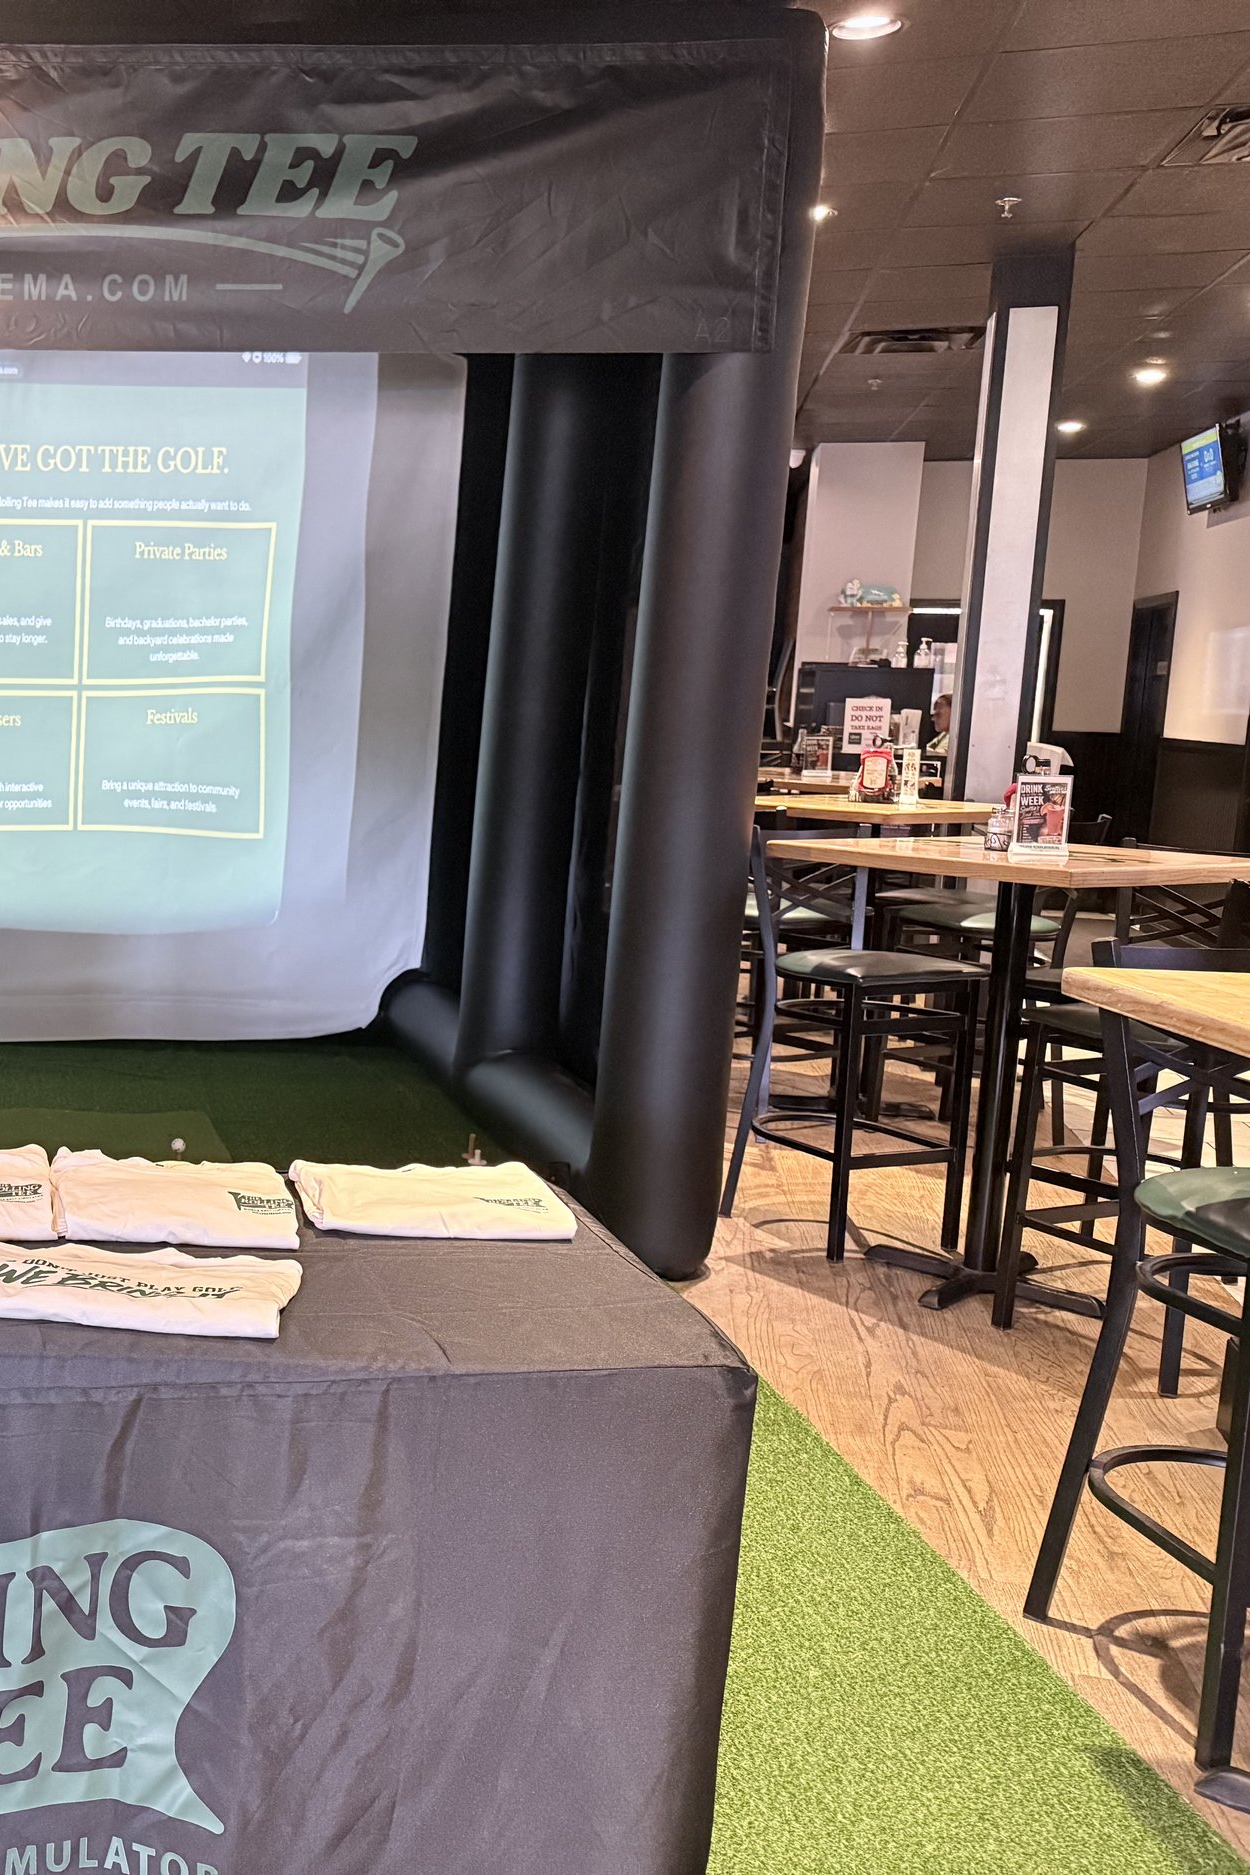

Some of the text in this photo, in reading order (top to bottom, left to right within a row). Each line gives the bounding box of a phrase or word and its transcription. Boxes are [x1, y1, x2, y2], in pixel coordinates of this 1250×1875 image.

[173, 133, 419, 219] TEE
[36, 444, 94, 473] GOT
[98, 445, 150, 474] THE
[156, 447, 229, 475] GOLF.
[23, 497, 37, 508] Tee
[38, 497, 64, 509] makes
[70, 499, 89, 511] easy
[89, 498, 97, 509] to
[98, 498, 113, 509] add
[113, 498, 151, 511] something
[152, 499, 180, 512] people
[180, 499, 209, 512] actually
[209, 500, 229, 511] want
[230, 501, 238, 511] to
[0, 540, 11, 557] &
[14, 540, 43, 557] Bars
[134, 541, 228, 561] Private Parties
[20, 616, 35, 627] and
[35, 615, 52, 628] give
[105, 615, 248, 630] Birthdays, graduations, bachelor parties,
[4, 633, 22, 645] stay
[22, 633, 48, 646] longer.
[118, 632, 234, 647] and backyard celebrations made
[146, 708, 198, 725] Festivals
[5, 782, 44, 793] interactive
[102, 779, 122, 792] Bring
[129, 780, 153, 793] unique
[153, 781, 189, 793] attraction
[189, 783, 197, 793] to
[198, 784, 240, 799] community
[1021, 784, 1043, 793] DRINK
[4, 798, 52, 811] opportunities
[123, 798, 150, 810] events,
[170, 799, 185, 811] and
[1020, 796, 1045, 806] WEEK
[136, 1281, 187, 1294] PLAY
